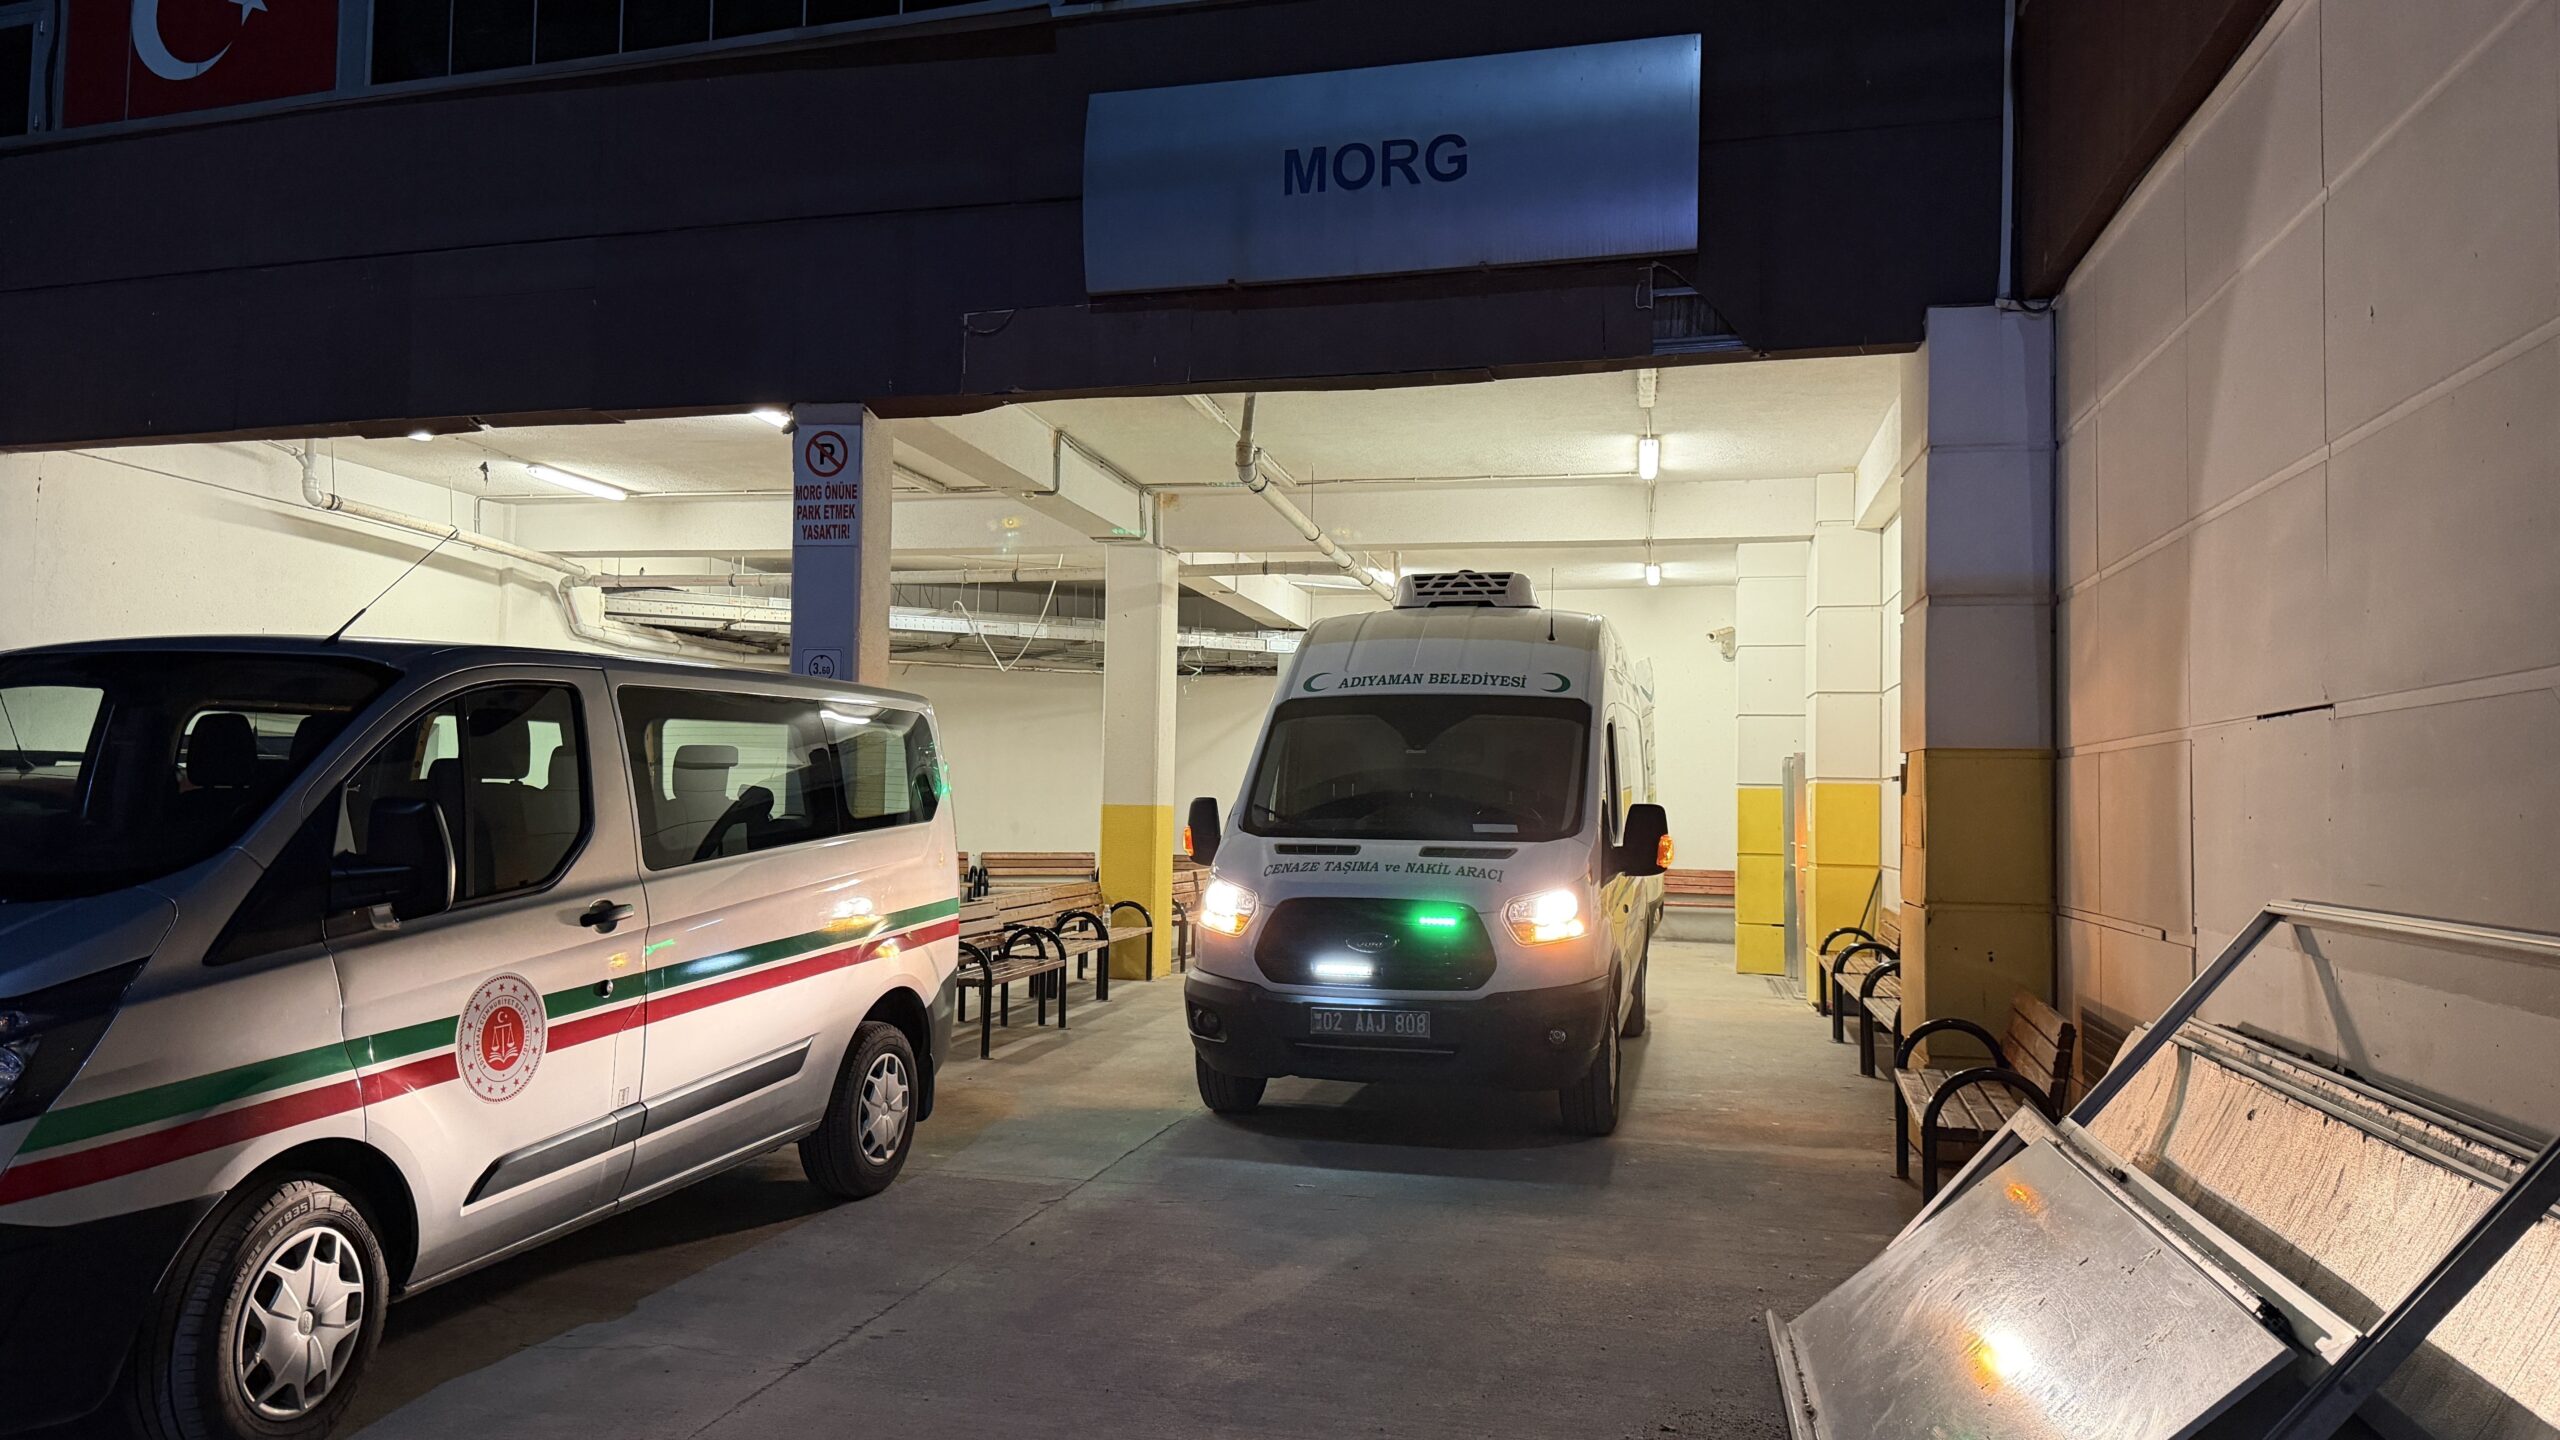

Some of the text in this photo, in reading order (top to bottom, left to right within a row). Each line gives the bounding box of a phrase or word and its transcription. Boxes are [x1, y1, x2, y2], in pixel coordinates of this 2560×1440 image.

[1284, 134, 1468, 196] MORG
[795, 481, 858, 501] MORG ÖNÜNE
[796, 503, 856, 520] PARK ETMEK
[801, 523, 850, 541] YASAKTIR!
[1337, 672, 1527, 689] ADIYAMAN BELEDİYESİ
[1263, 861, 1505, 883] CENAZE TAŞIMA ve NAKİL ARACI
[1323, 1012, 1426, 1034] 02 AAJ 808
[267, 1201, 309, 1238] PT835
